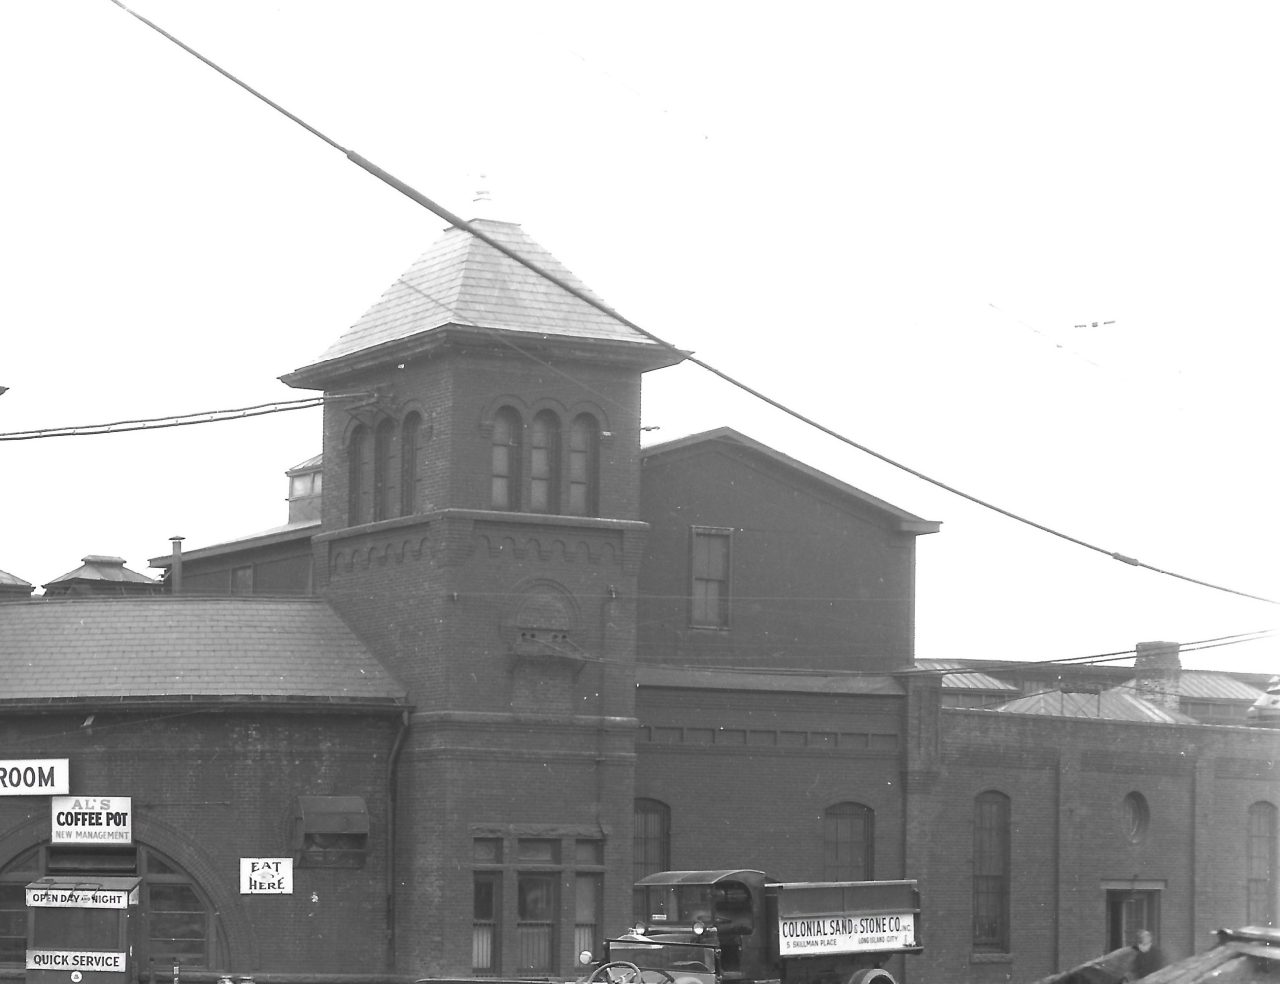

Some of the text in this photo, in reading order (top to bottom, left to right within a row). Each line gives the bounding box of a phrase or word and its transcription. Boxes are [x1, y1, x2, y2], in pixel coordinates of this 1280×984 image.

[71, 799, 111, 810] AL'S
[57, 812, 128, 826] COFFEE POT
[56, 830, 129, 839] NEW MANAGEMENT
[251, 861, 282, 872] EAT
[249, 876, 285, 890] HERE
[33, 893, 58, 902] OPEN
[60, 894, 80, 903] DAY
[91, 895, 122, 904] NIGHT
[782, 921, 828, 938] COLONIAL
[829, 919, 853, 935] SAND
[860, 917, 887, 934] STONE
[820, 938, 837, 947] PLACE
[33, 954, 120, 966] QUICK SERVICE
